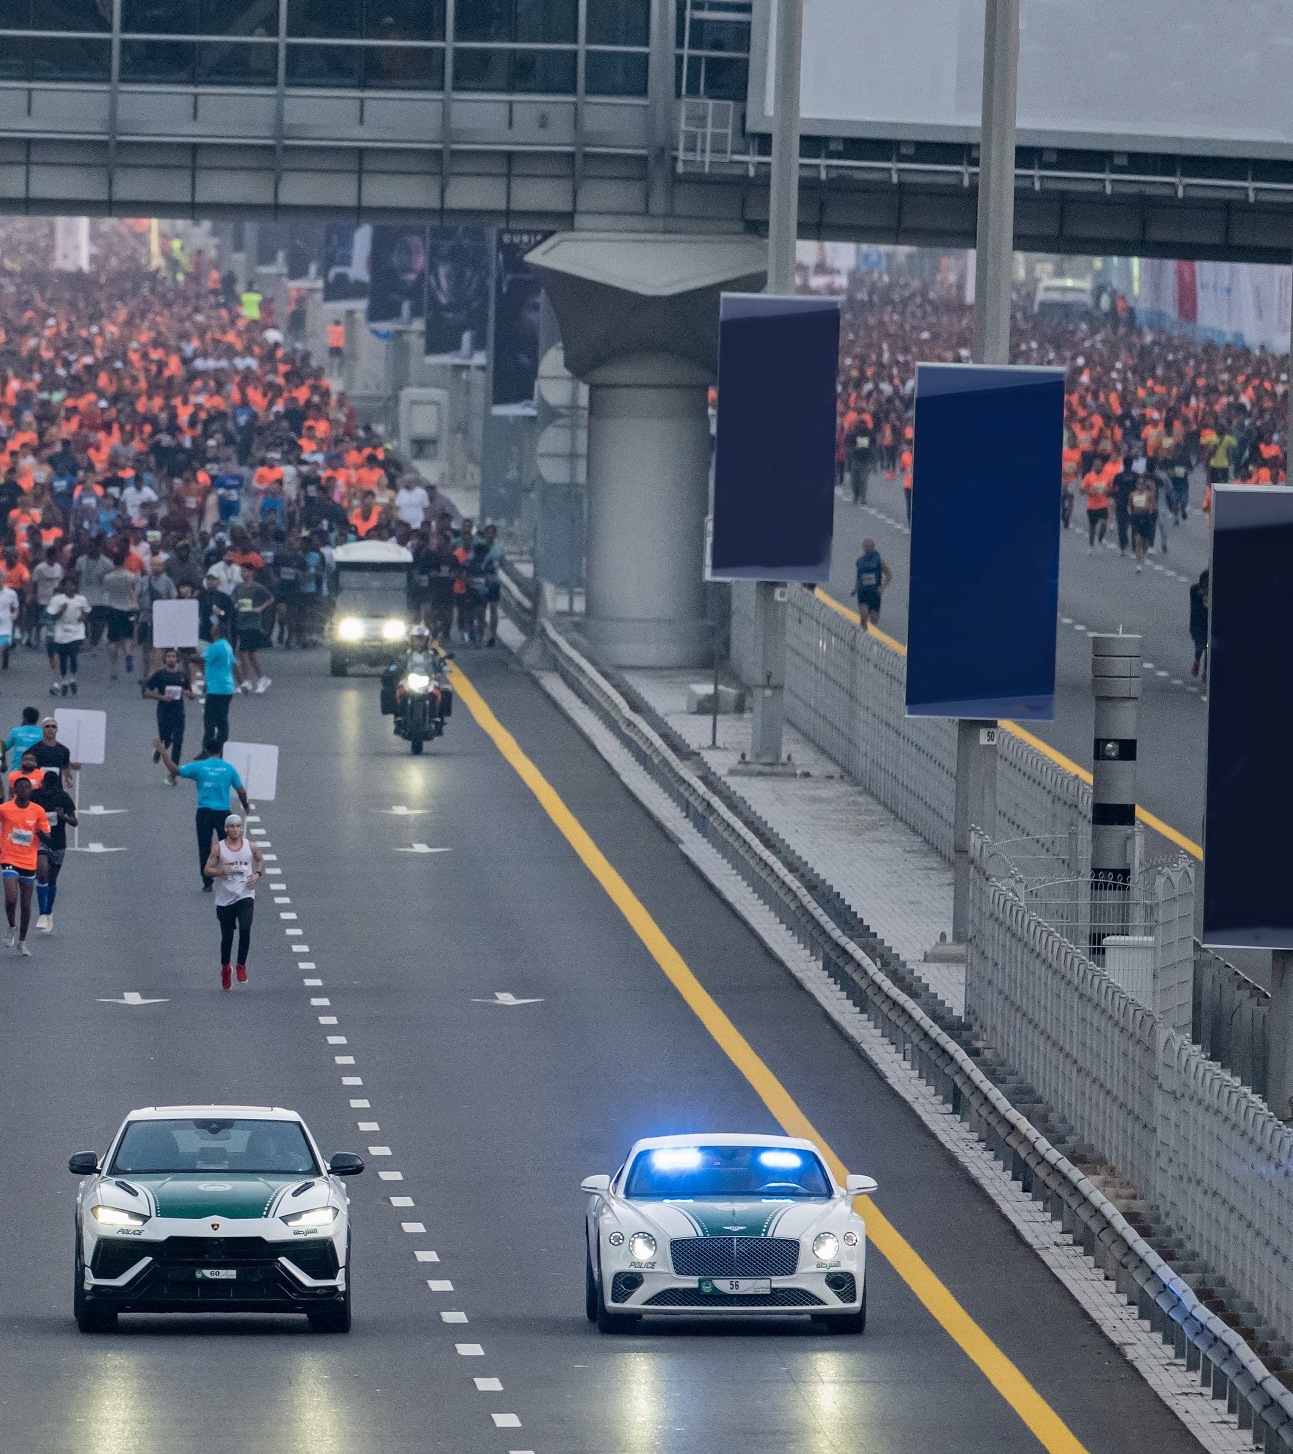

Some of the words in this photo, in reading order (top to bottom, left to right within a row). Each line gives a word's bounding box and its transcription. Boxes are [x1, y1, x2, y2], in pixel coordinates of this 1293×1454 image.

[987, 731, 995, 742] 50
[116, 1228, 145, 1236] POLICE
[628, 1261, 657, 1269] POLICE
[729, 1280, 740, 1290] 56
